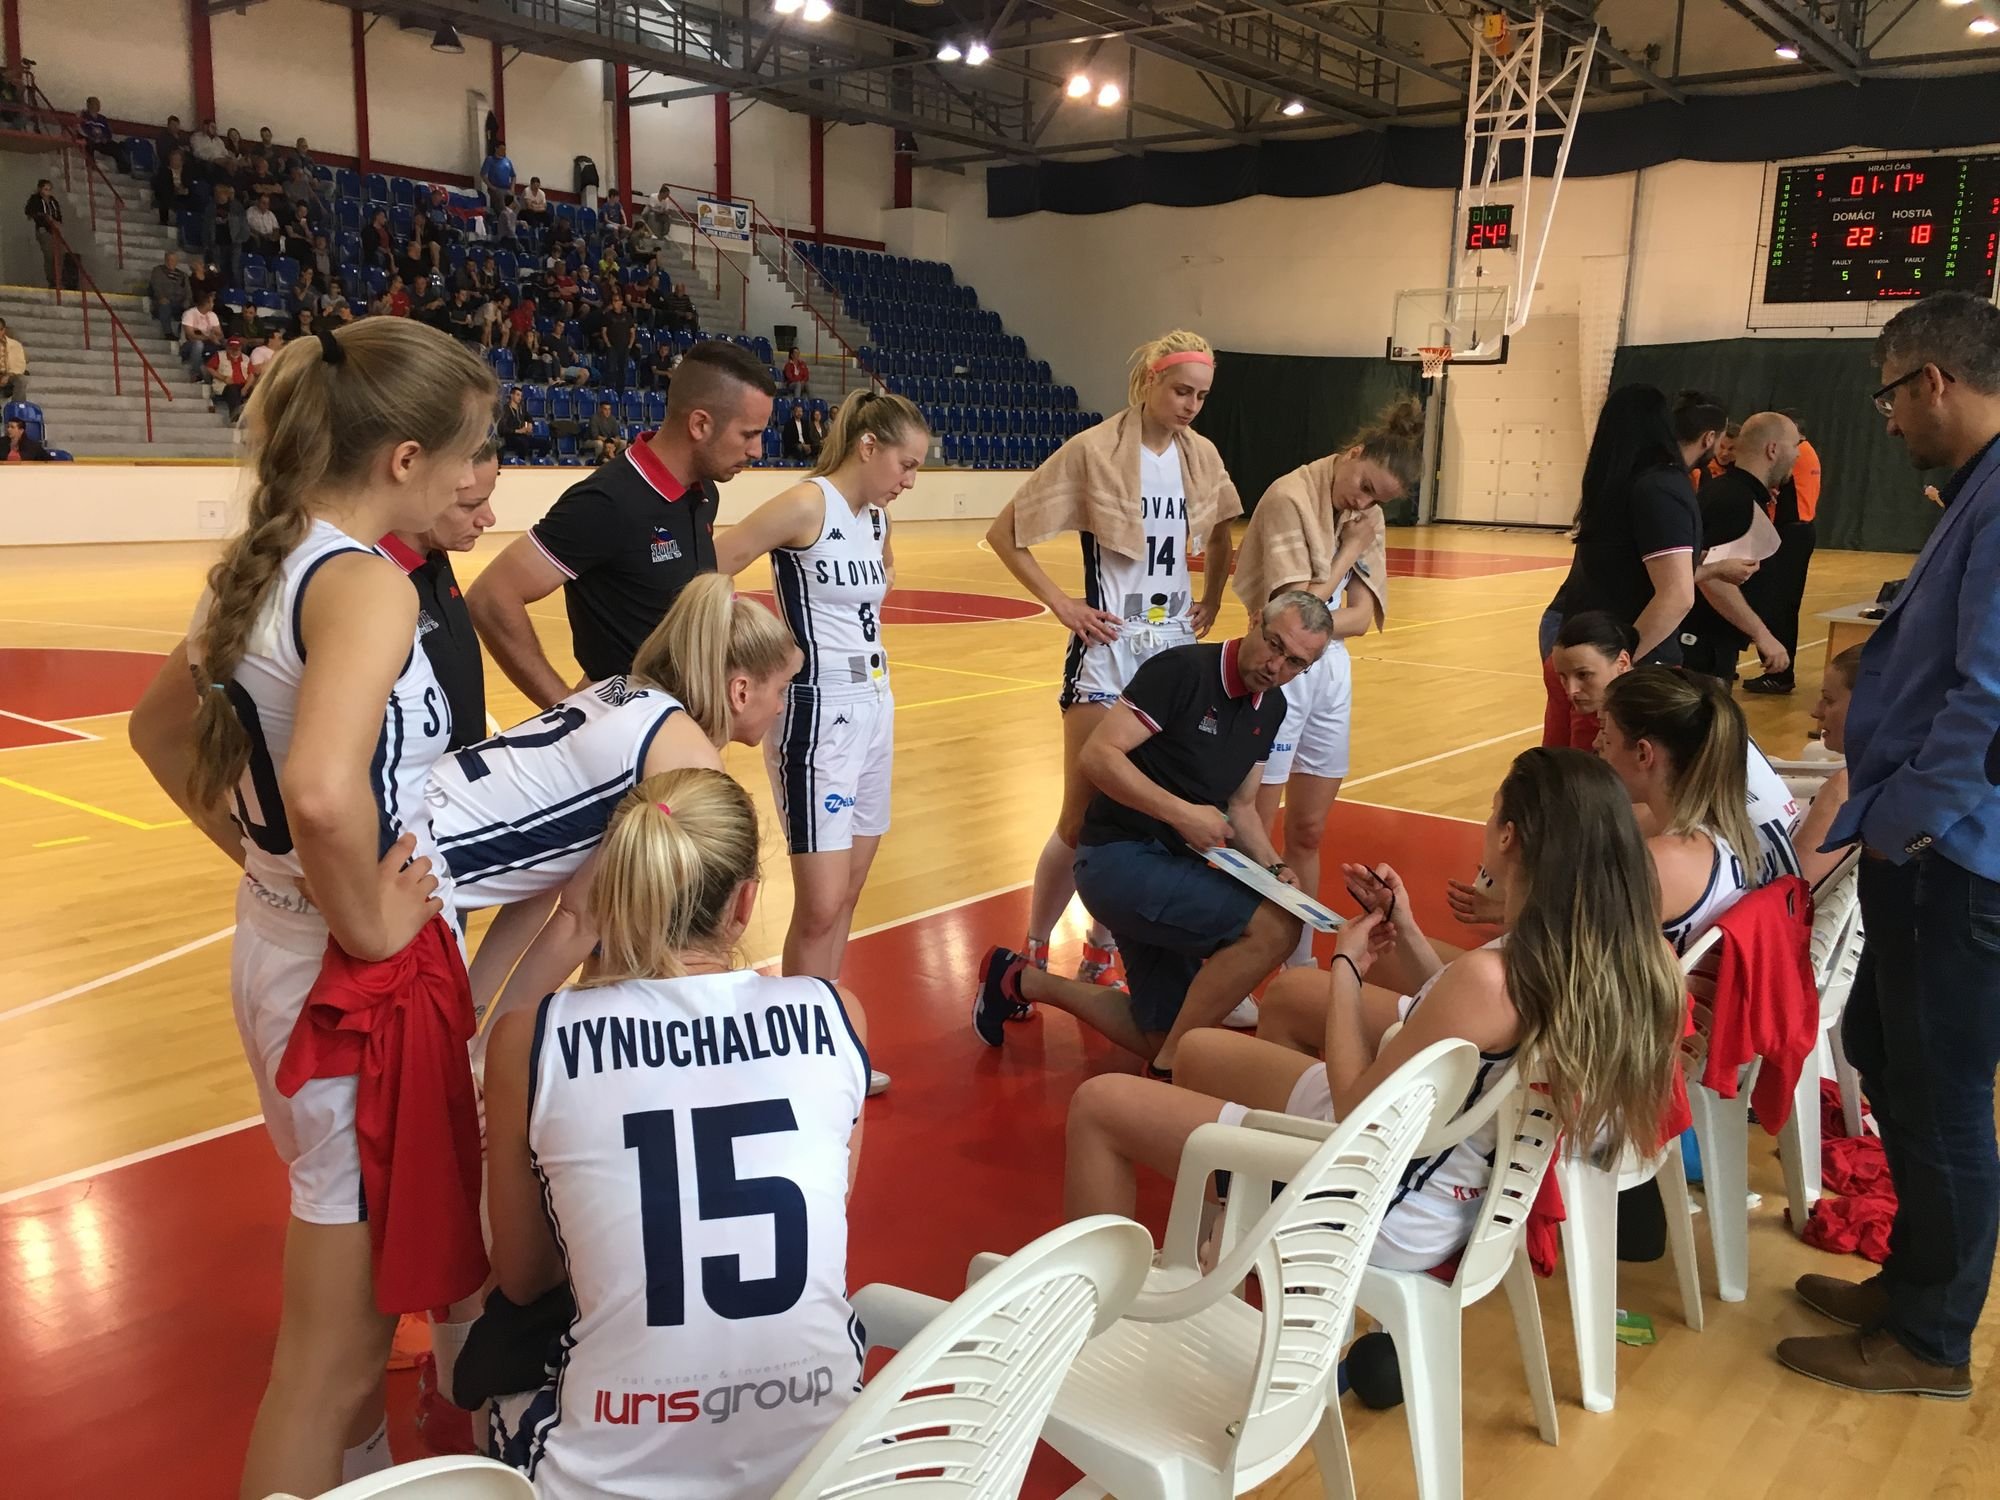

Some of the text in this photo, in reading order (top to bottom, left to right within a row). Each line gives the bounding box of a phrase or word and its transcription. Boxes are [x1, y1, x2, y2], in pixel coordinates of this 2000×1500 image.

[1832, 209, 1875, 222] DOMÁCI
[1892, 208, 1933, 219] HOSTIA
[1846, 226, 1874, 247] 22
[1911, 224, 1931, 244] 18
[1842, 270, 1848, 280] 5
[1877, 270, 1881, 280] 1
[1914, 268, 1922, 278] 5
[1146, 536, 1175, 576] 14
[557, 1003, 836, 1080] VYNUCHALOVA
[622, 1097, 808, 1327] 15
[654, 1373, 708, 1386] estate
[719, 1370, 728, 1379] &
